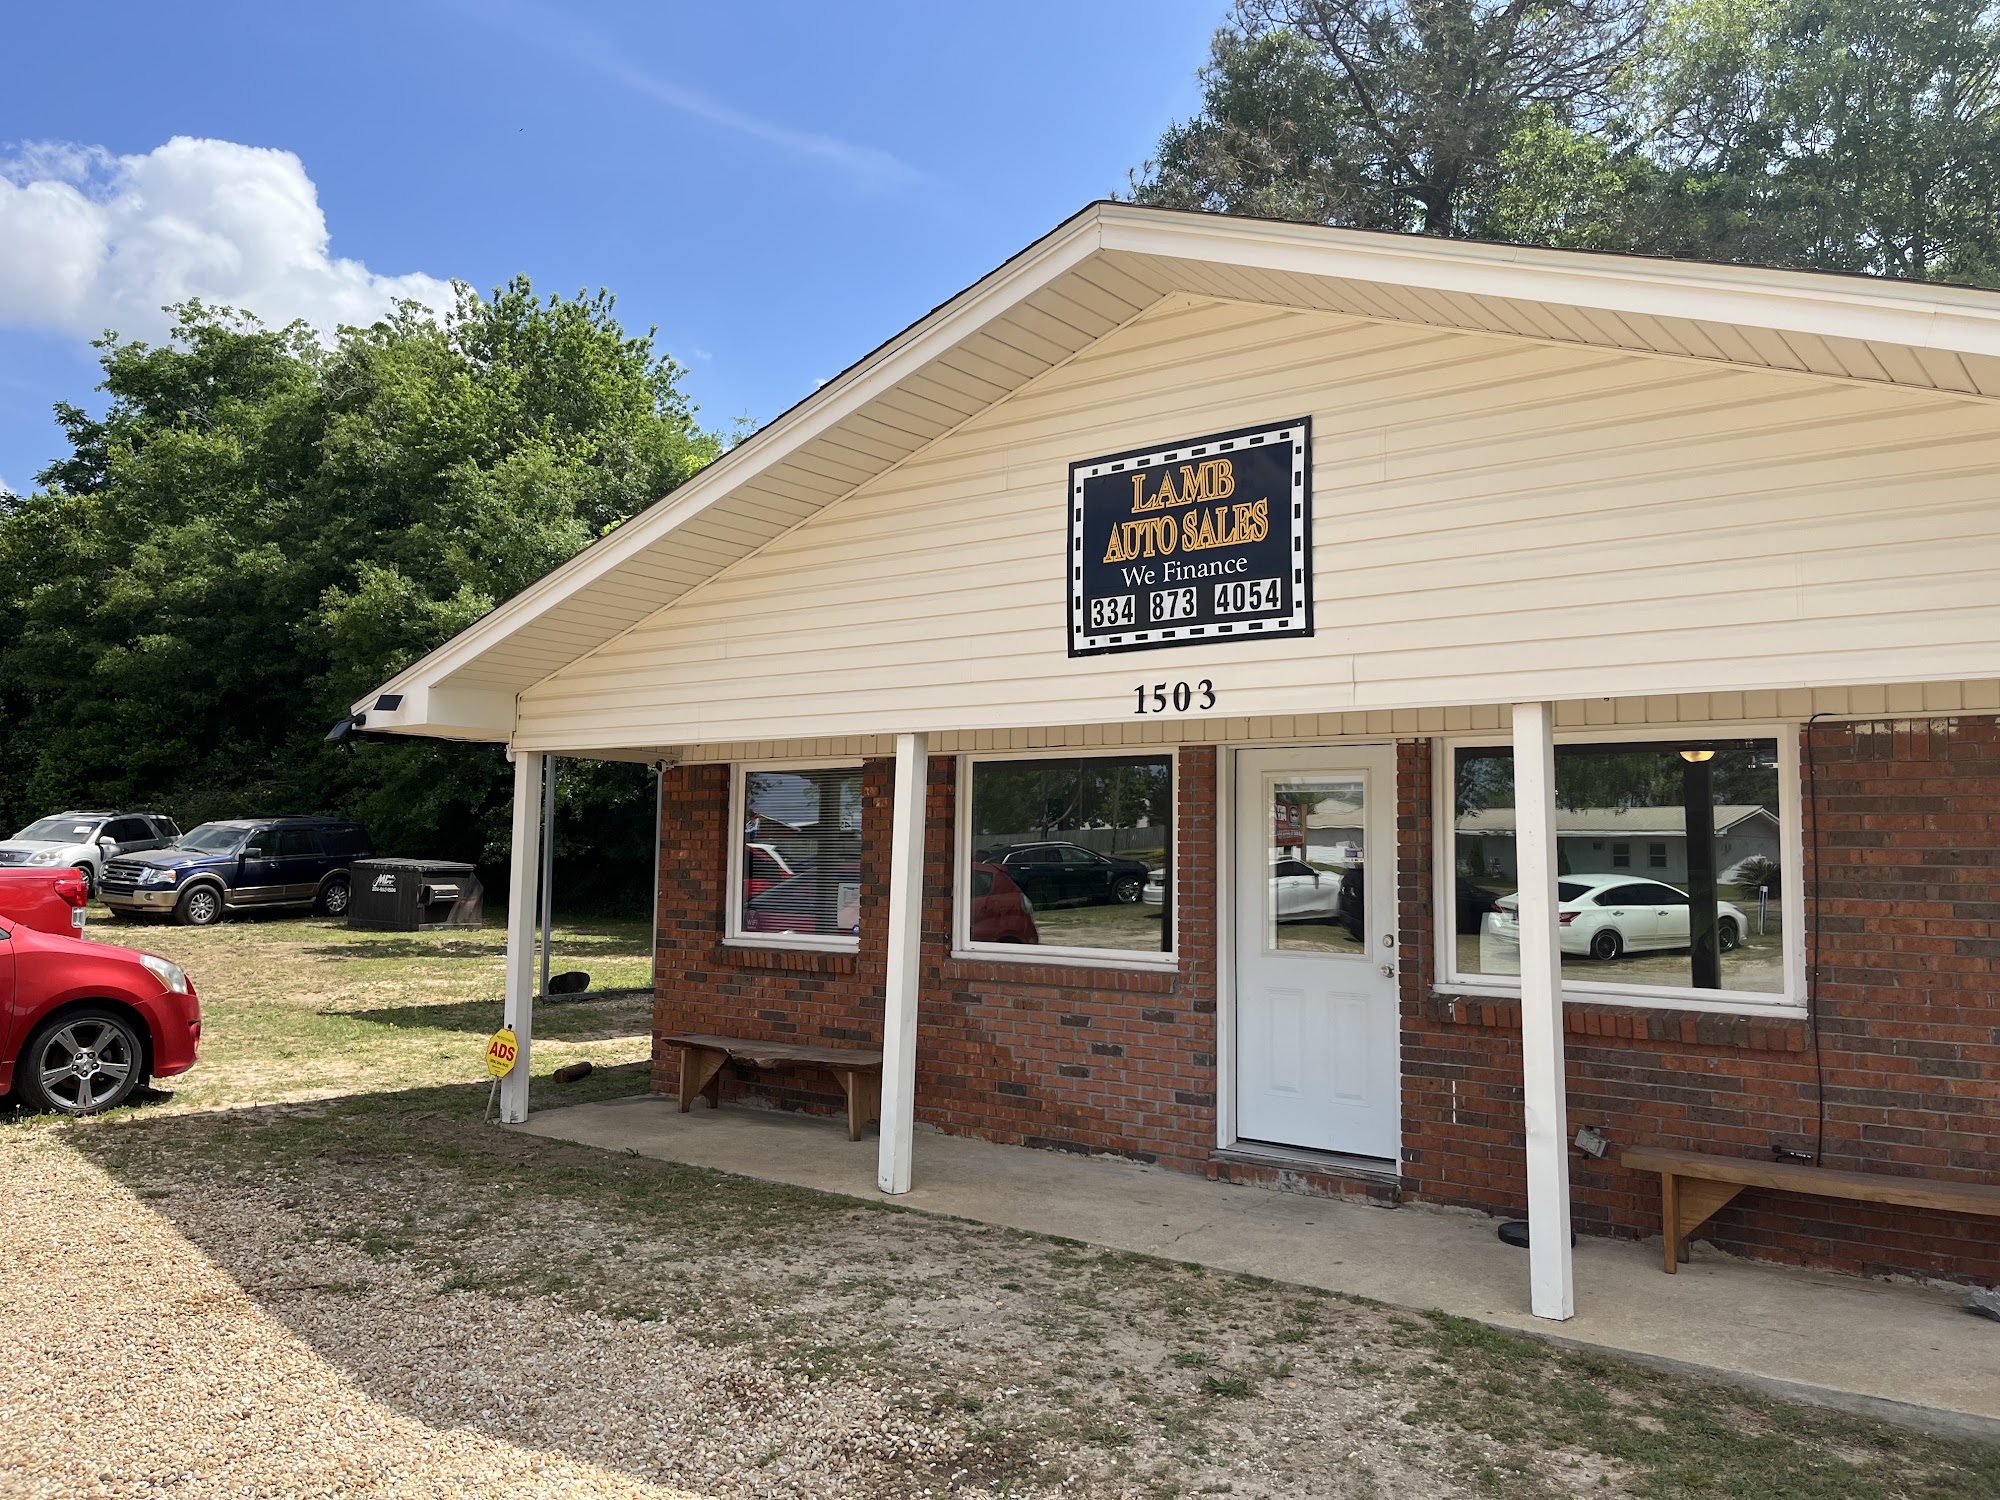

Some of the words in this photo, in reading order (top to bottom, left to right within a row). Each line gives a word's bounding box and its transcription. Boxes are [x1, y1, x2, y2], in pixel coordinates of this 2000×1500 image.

[1131, 458, 1235, 513] LAMB
[1103, 515, 1178, 563] AUTO
[1182, 497, 1269, 551] SALES
[1122, 564, 1156, 587] We
[1163, 555, 1248, 583] Finance
[1093, 596, 1134, 627] 334
[1152, 588, 1195, 620] 873
[1216, 579, 1280, 613] 4054
[1133, 679, 1217, 714] 1503
[489, 1041, 516, 1062] ADS
